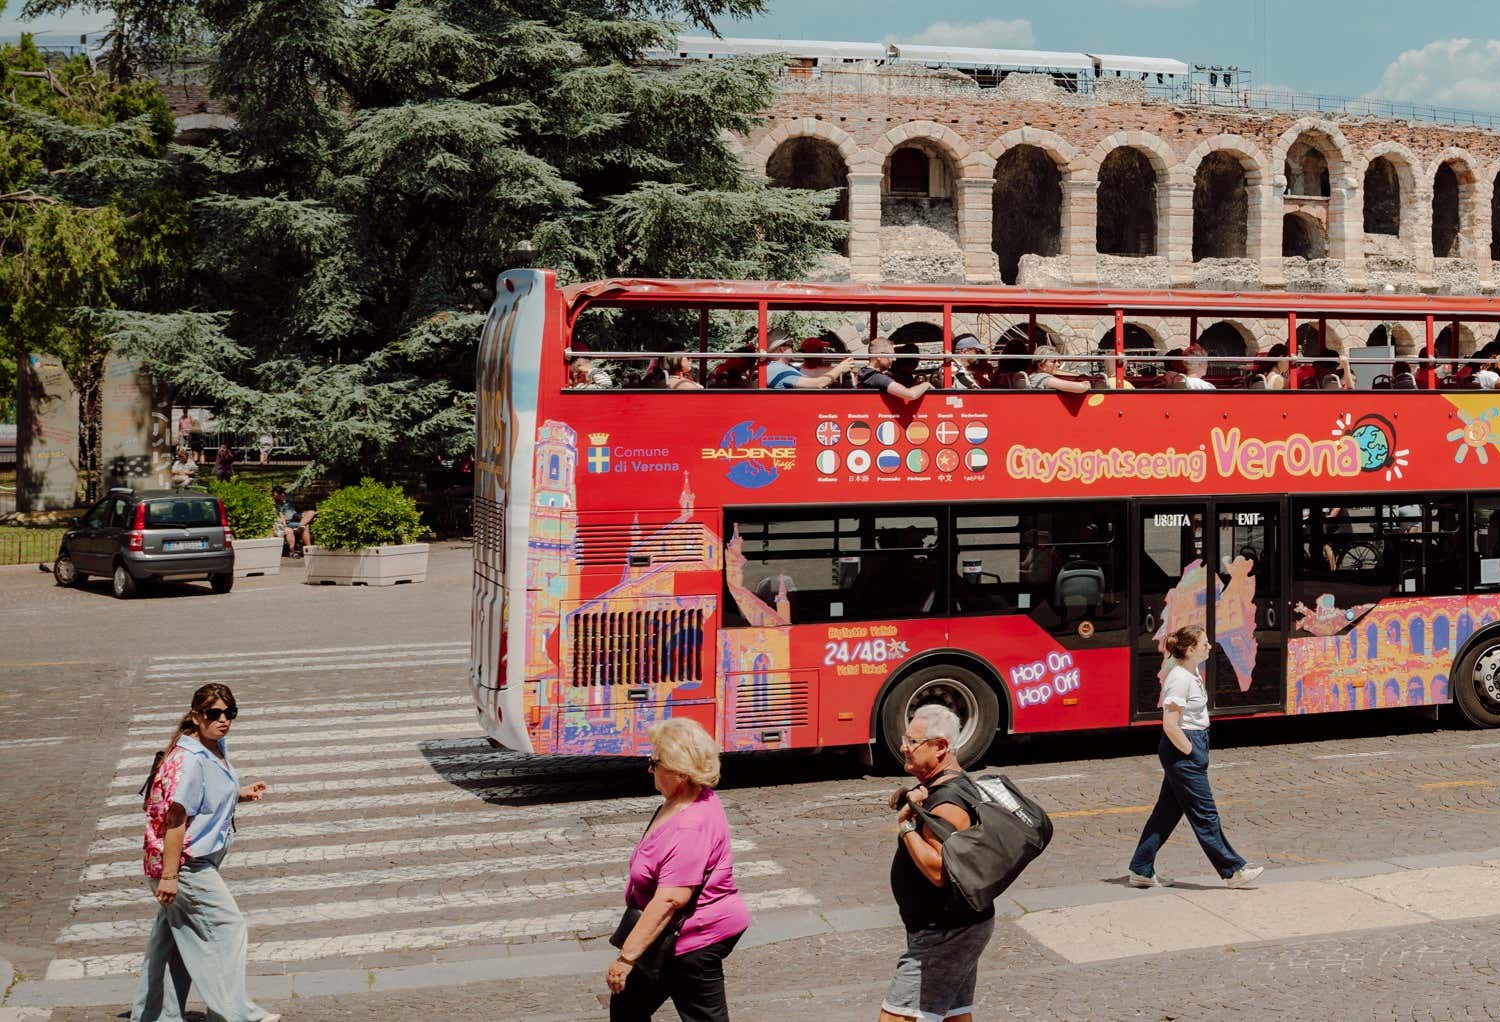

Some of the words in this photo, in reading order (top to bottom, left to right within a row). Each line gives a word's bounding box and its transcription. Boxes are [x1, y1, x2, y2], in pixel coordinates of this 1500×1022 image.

[614, 446, 670, 458] Comune
[701, 447, 797, 459] BALDENSE
[1007, 444, 1207, 484] CitySightseeing
[1211, 427, 1362, 480] Verona
[614, 461, 627, 472] di
[628, 461, 680, 472] Verona
[1154, 514, 1191, 527] USCITA
[1238, 512, 1261, 525] EXIT
[824, 639, 888, 666] 24/48
[1010, 661, 1045, 686] Hop
[1048, 651, 1074, 674] On
[1016, 683, 1052, 708] Hop
[1054, 669, 1081, 694] Off
